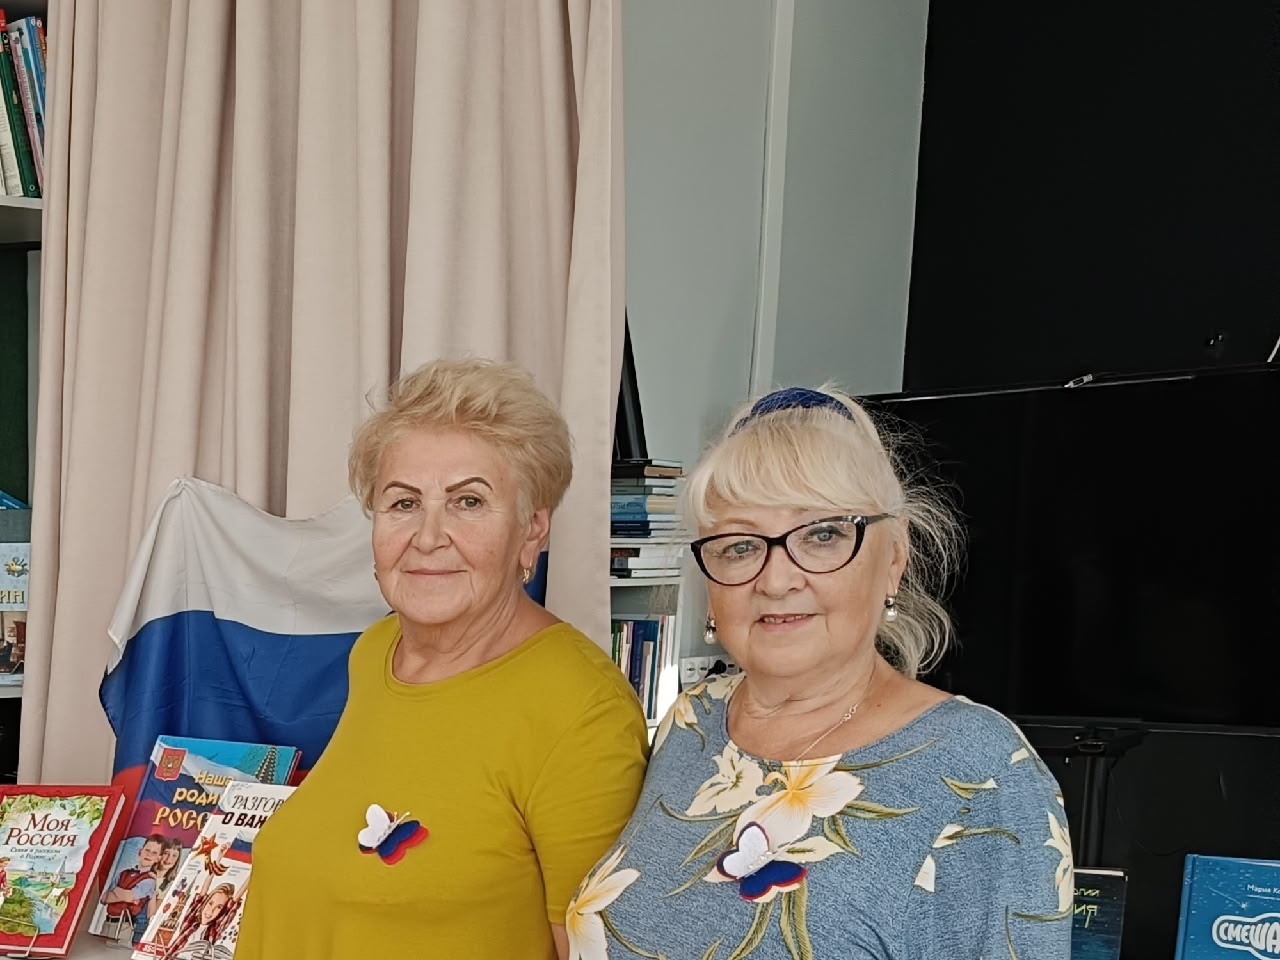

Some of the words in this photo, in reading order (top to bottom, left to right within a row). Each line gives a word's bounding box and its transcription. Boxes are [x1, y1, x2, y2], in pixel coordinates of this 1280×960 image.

[194, 770, 235, 788] Наша
[23, 812, 73, 832] Моя
[221, 811, 234, 825] О
[1, 827, 79, 848] Россия
[1246, 883, 1272, 894] Мария
